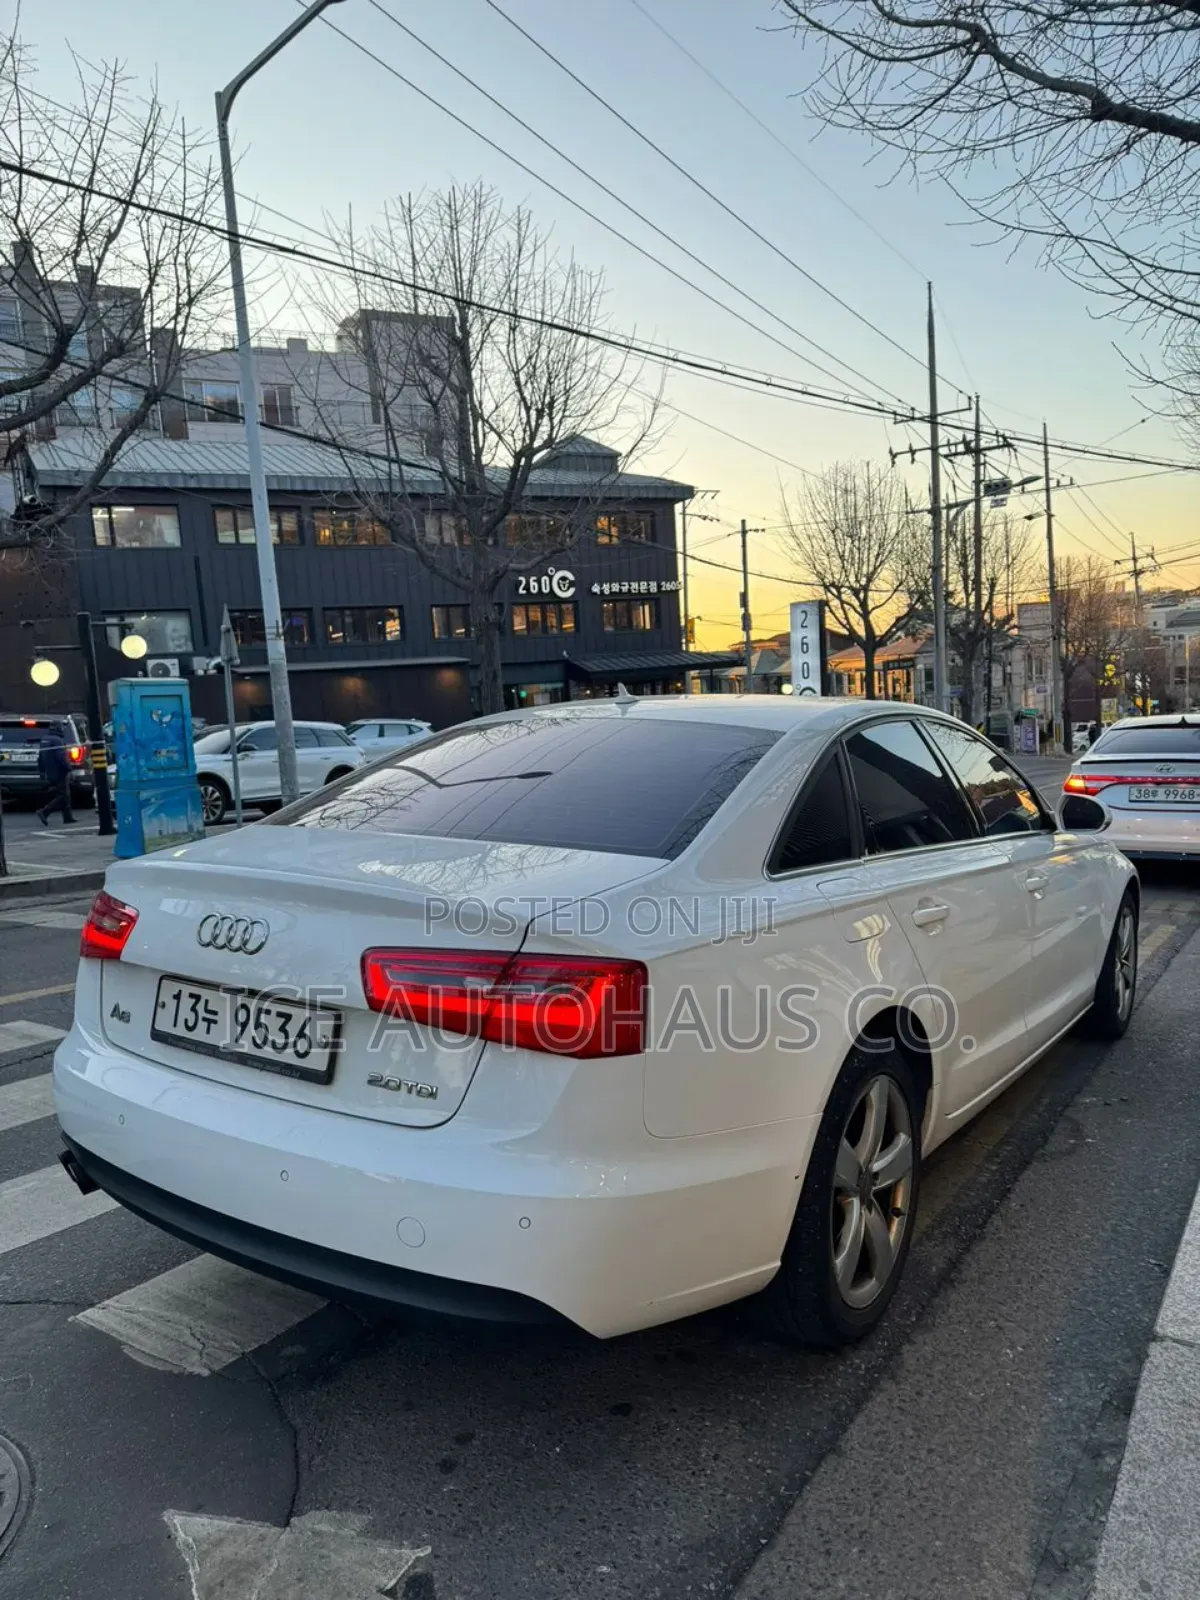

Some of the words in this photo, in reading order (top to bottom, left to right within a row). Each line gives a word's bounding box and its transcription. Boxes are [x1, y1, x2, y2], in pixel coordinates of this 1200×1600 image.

[1164, 788, 1196, 800] 9968
[172, 989, 219, 1035] 13누
[234, 1003, 312, 1060] 9536
